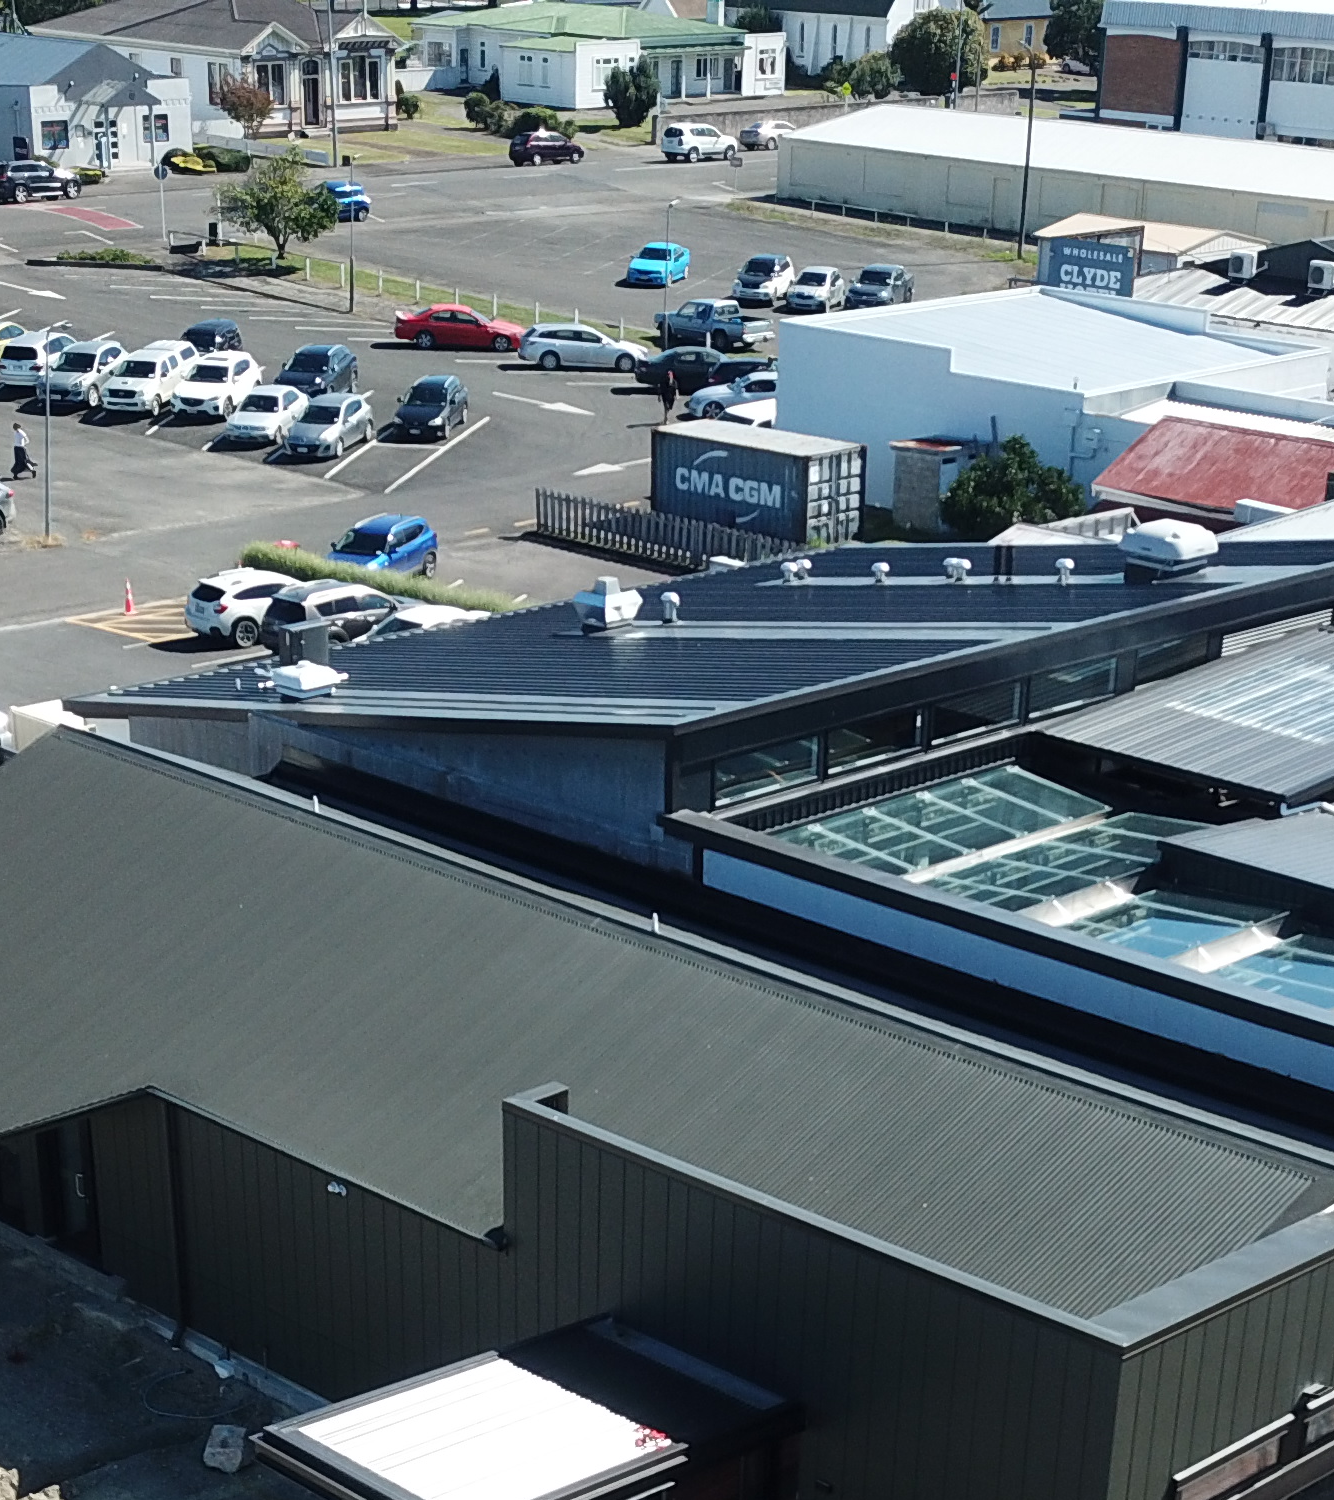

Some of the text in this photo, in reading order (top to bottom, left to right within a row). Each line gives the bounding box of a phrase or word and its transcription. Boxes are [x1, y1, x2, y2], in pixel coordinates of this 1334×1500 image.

[1062, 246, 1124, 263] WHOLESALE
[1060, 264, 1121, 289] CLYDE
[675, 466, 781, 508] CMA CGM
